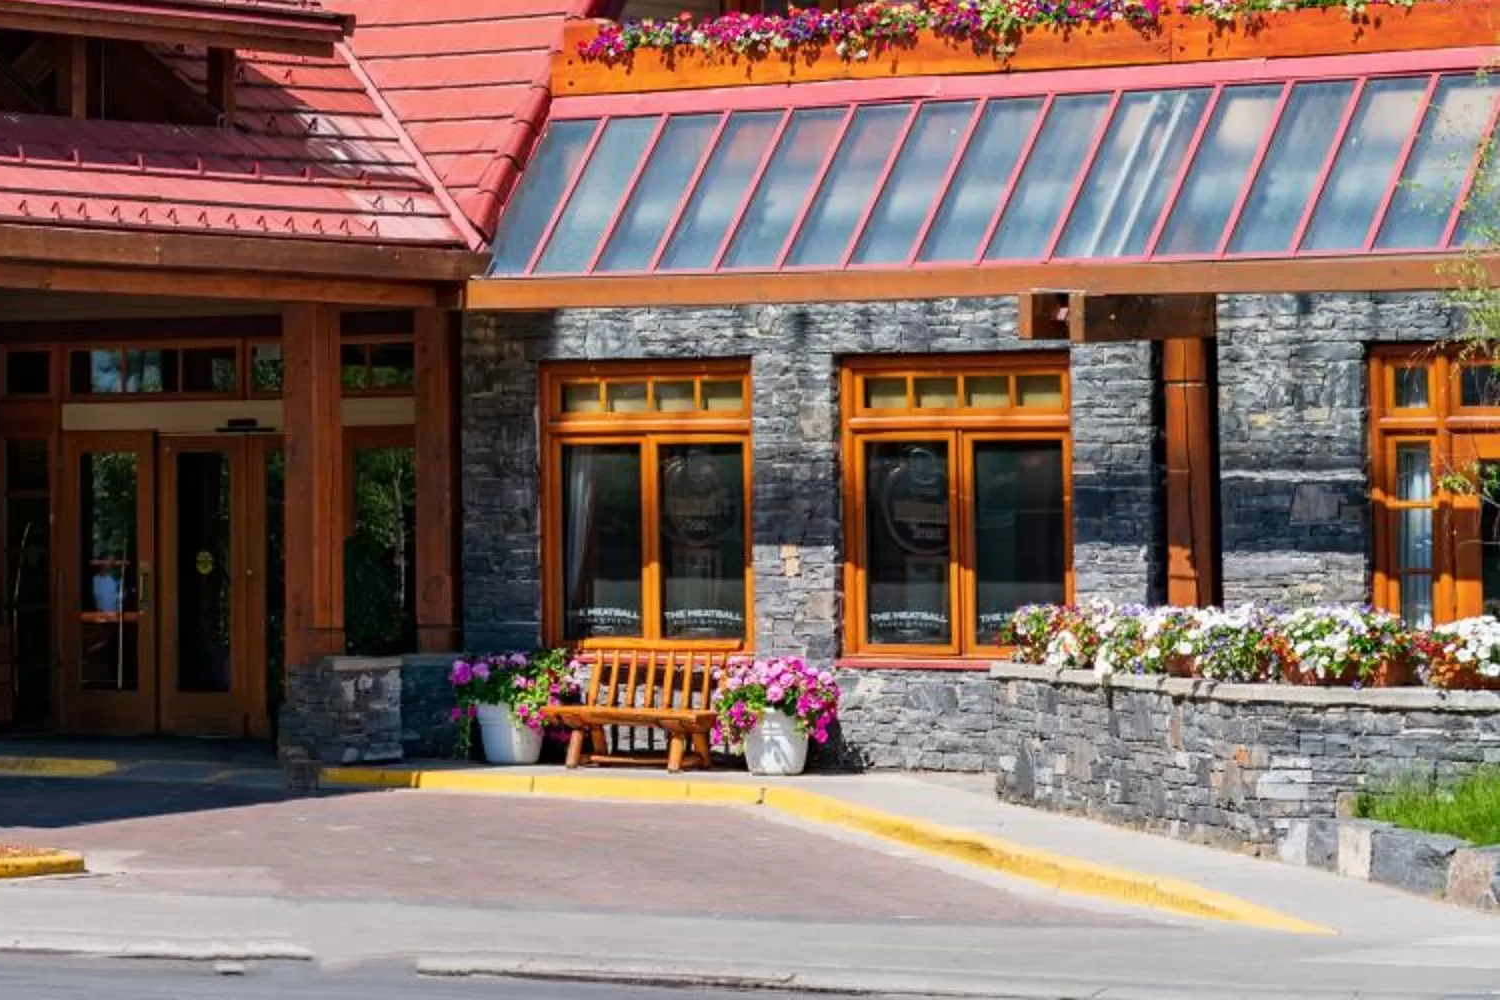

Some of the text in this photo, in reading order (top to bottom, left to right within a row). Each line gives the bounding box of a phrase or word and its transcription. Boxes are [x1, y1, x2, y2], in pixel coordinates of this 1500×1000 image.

[587, 607, 641, 620] MEATBALL
[664, 608, 743, 621] THE MEATBALL
[870, 611, 948, 623] THE MEATBALL
